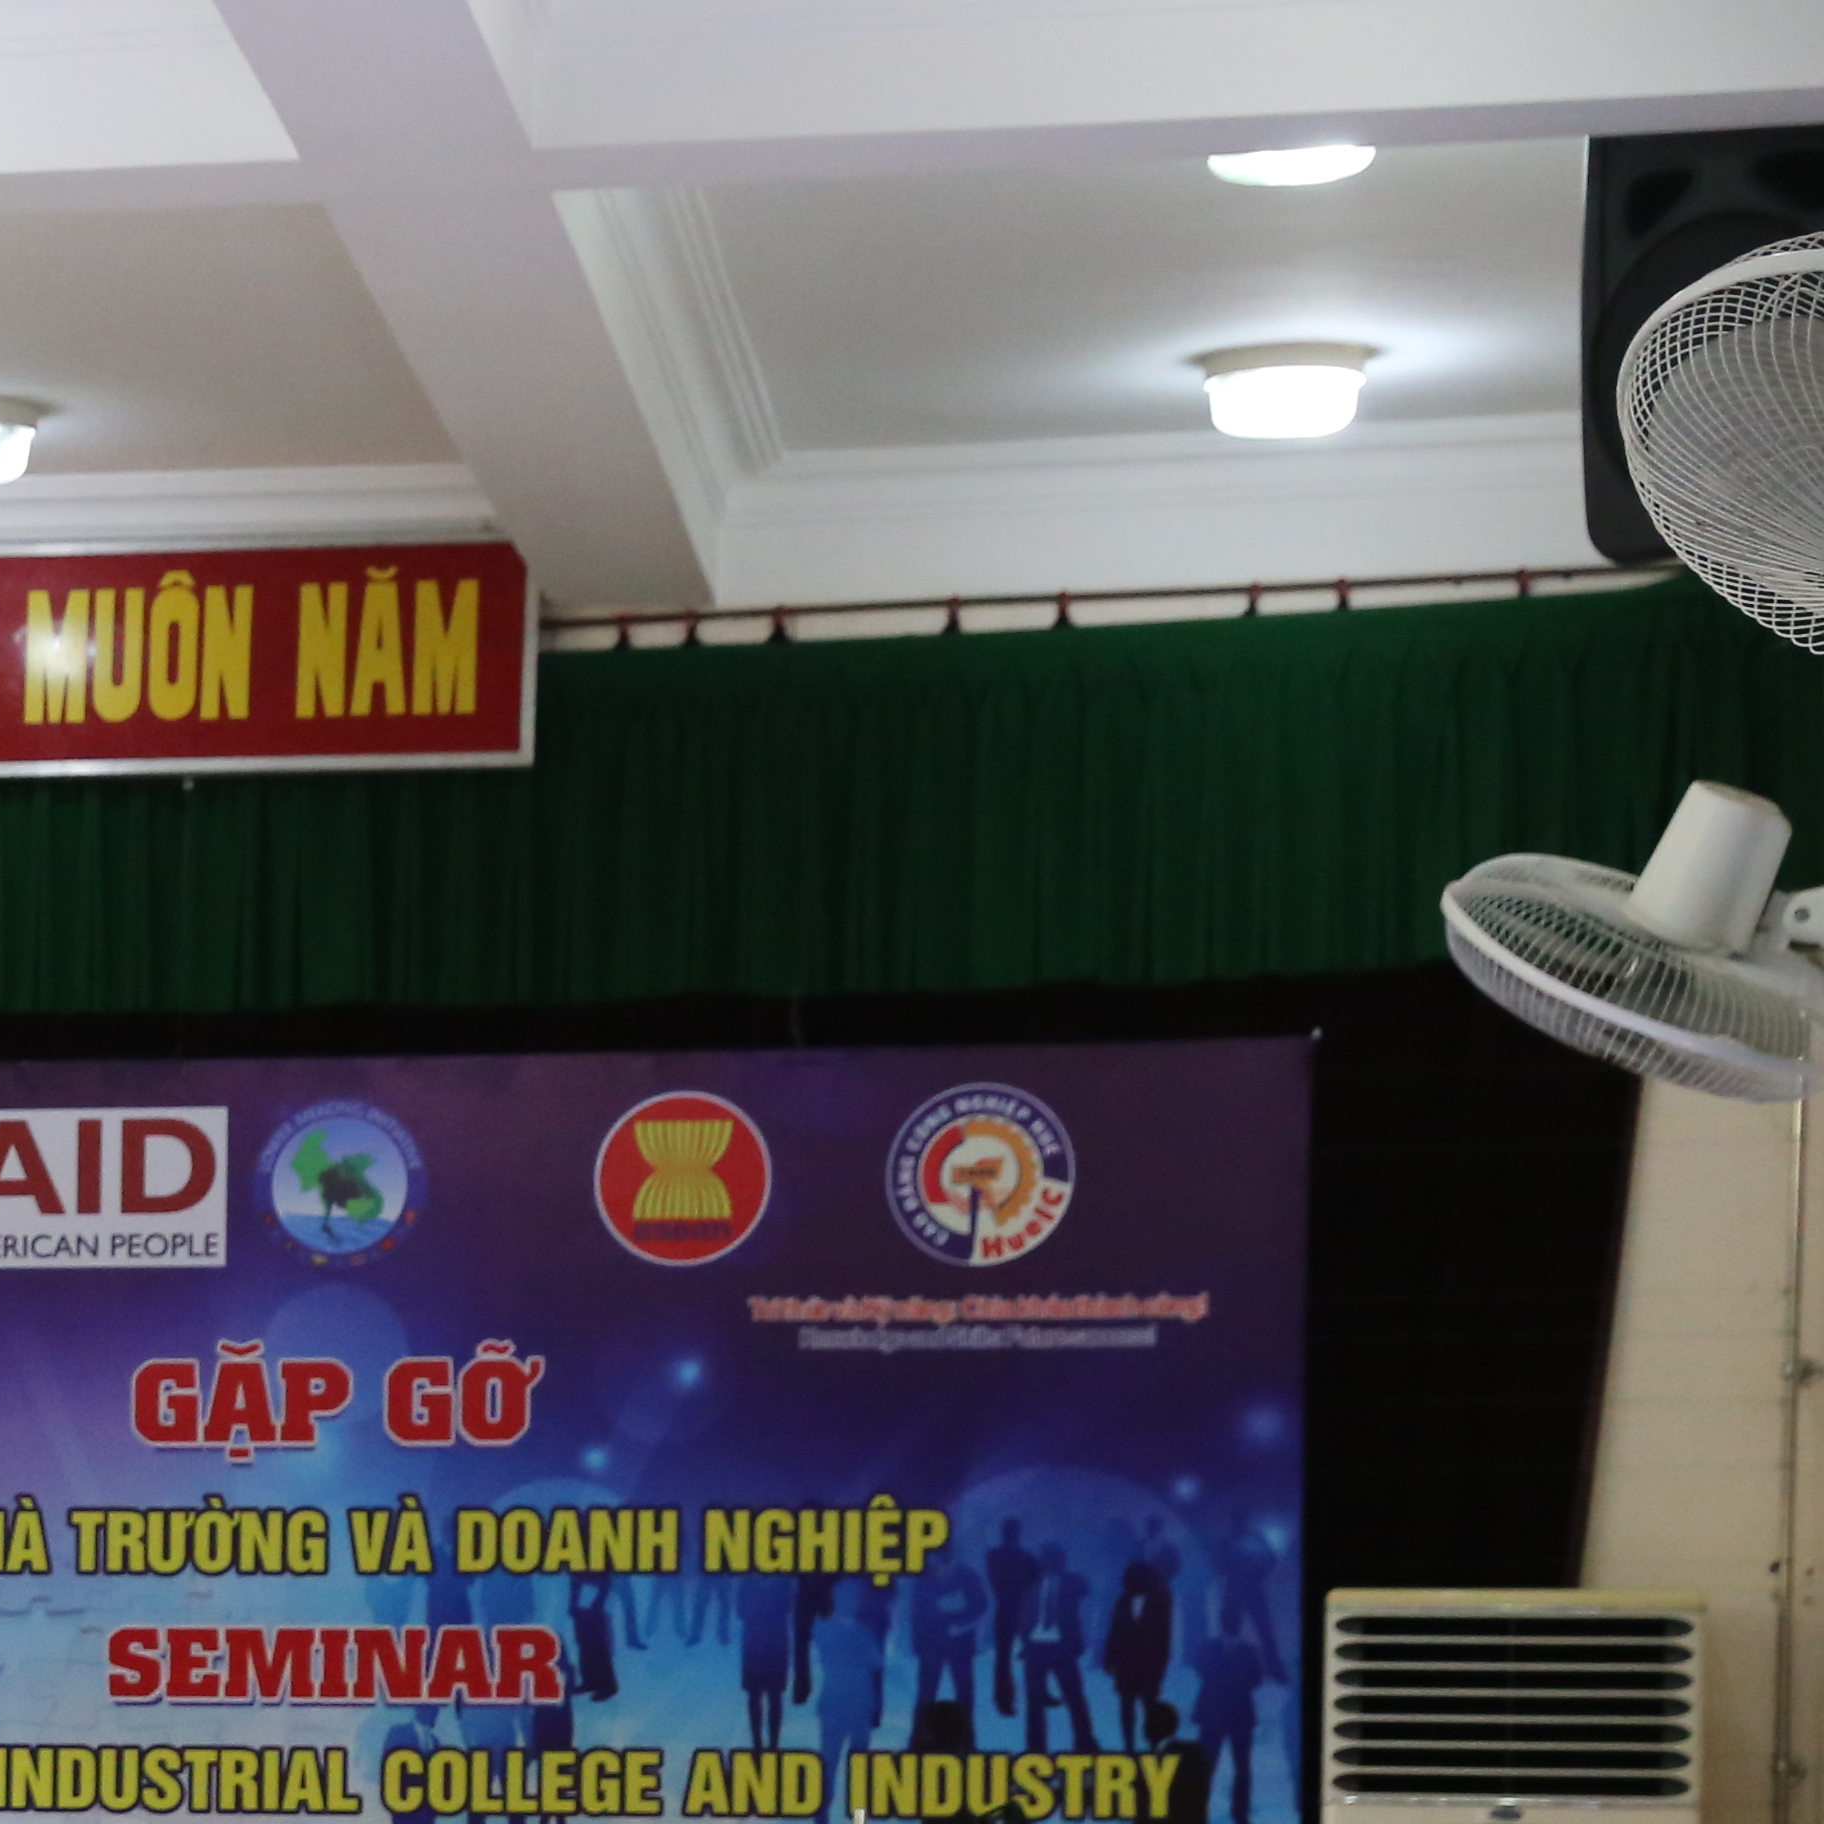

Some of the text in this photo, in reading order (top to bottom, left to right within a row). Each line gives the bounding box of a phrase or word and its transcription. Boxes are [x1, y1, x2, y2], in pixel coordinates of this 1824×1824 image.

[23, 570, 254, 725] MUÔN
[295, 567, 479, 719] NĂM
[110, 1231, 219, 1258] PEOPLE
[131, 1341, 545, 1461] GẶP GỠ
[69, 1495, 328, 1574] TRƯỜNG
[350, 1496, 434, 1573] VÀ
[456, 1508, 679, 1574] DOANH
[704, 1493, 949, 1587] NGHIỆP
[107, 1625, 563, 1703] SEMINAR
[382, 1748, 662, 1815] COLLEGE
[685, 1750, 824, 1816] AND
[848, 1752, 1181, 1819] INDUSTRY
